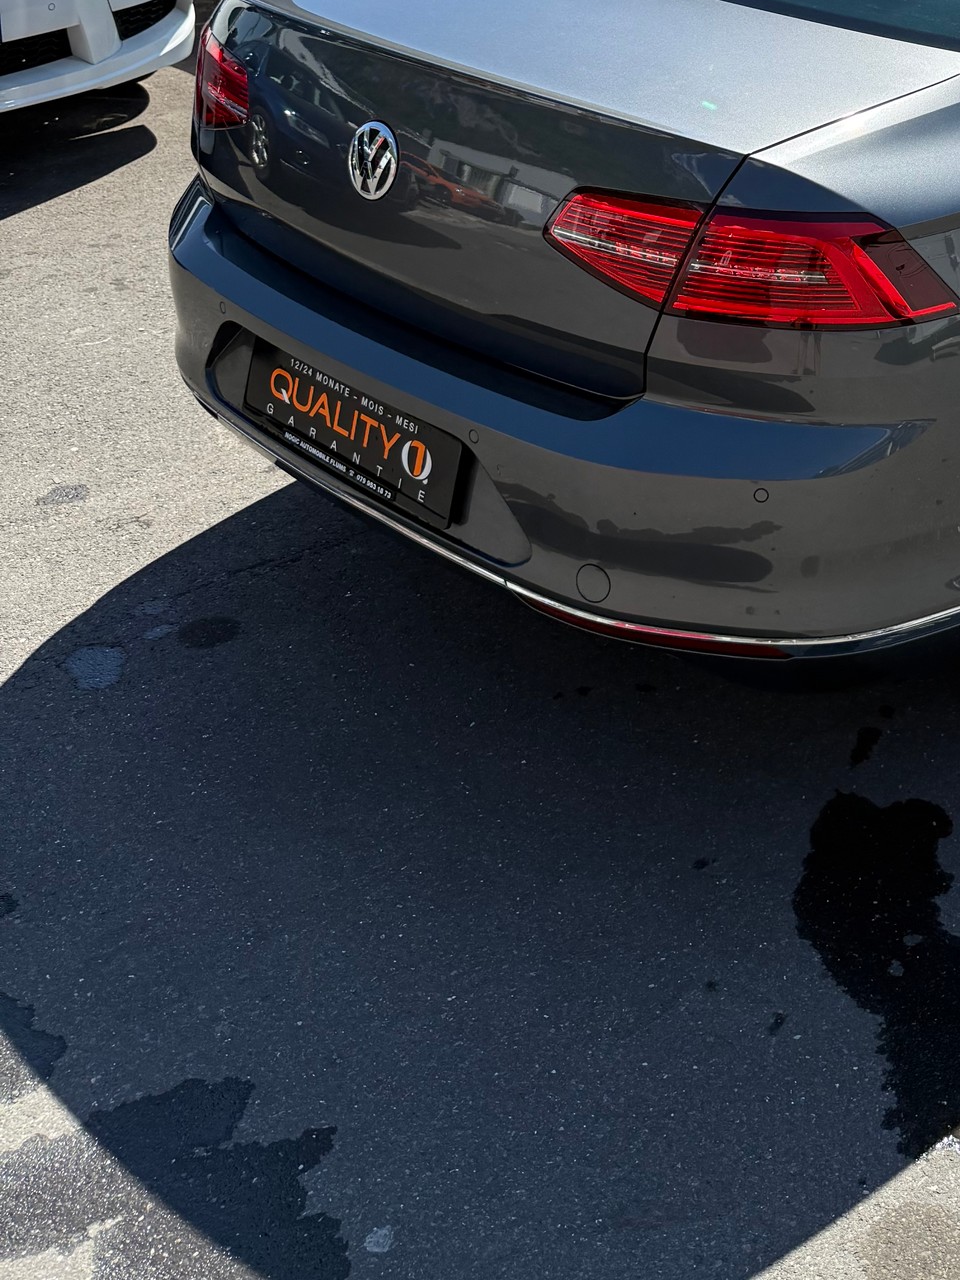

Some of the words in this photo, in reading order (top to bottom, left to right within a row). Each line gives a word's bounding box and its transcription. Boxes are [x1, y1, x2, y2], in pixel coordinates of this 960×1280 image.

[270, 368, 401, 460] QUALITY
[290, 358, 313, 377] 12/24
[315, 371, 350, 398] MONATE
[360, 396, 384, 415] MOIS
[395, 414, 419, 434] MESI
[299, 440, 330, 463] AUTOMOBILE
